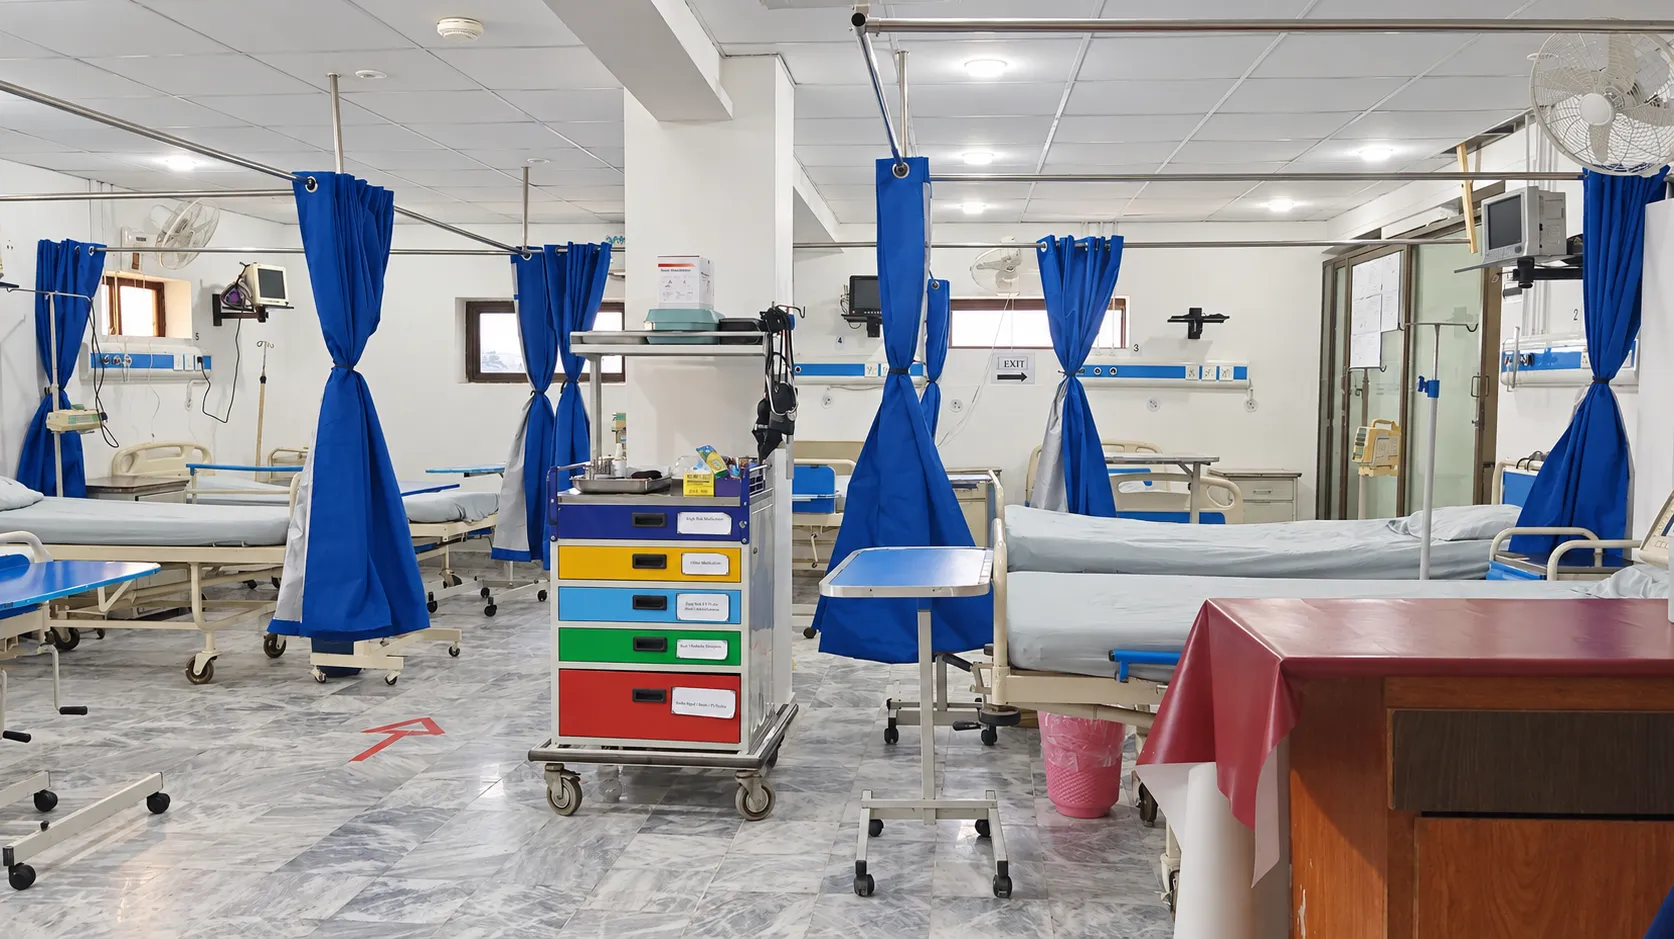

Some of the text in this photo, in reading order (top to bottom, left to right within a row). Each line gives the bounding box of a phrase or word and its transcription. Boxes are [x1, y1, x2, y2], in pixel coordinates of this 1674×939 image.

[1573, 308, 1579, 321] 2
[195, 332, 200, 341] 5
[837, 336, 843, 344] 4
[1133, 343, 1140, 352] 3
[1003, 359, 1025, 368] EXIT
